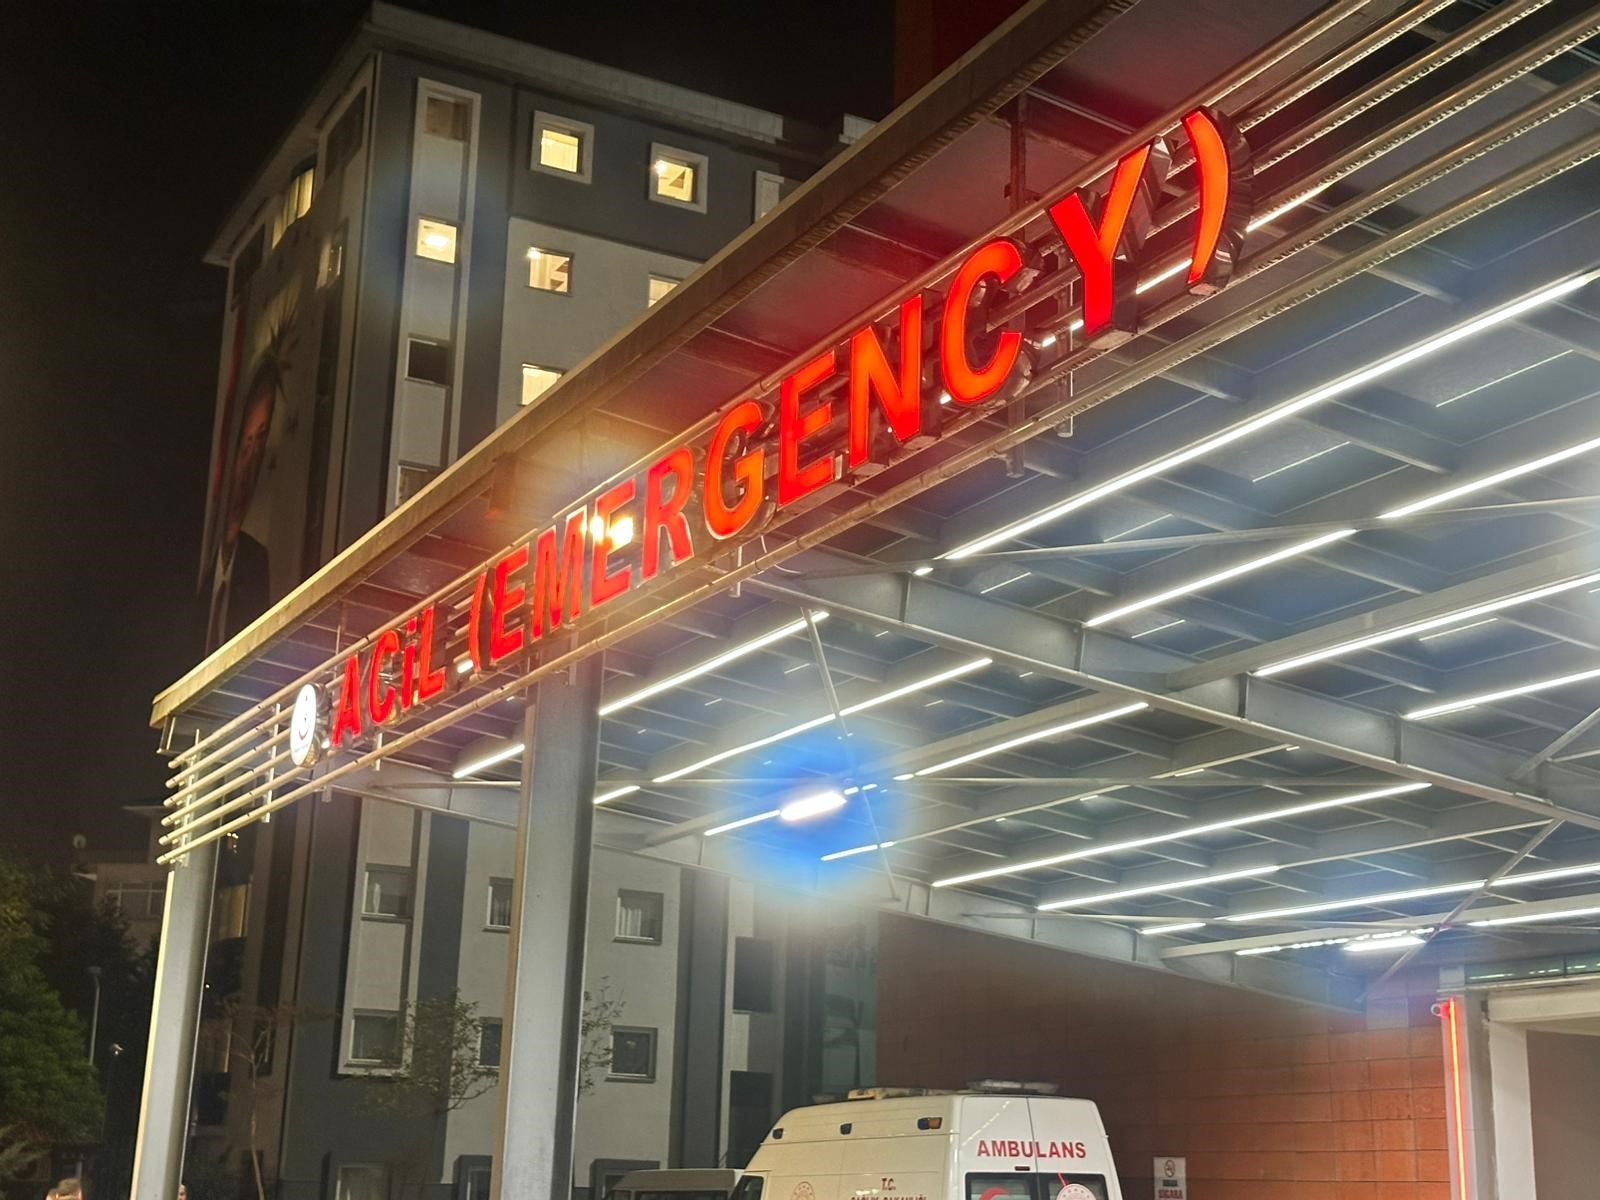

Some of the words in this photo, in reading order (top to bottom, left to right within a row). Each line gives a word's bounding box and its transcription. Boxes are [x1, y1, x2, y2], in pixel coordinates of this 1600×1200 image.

[331, 604, 446, 747] ACİL
[468, 109, 1231, 673] (EMERGENCY)
[977, 1140, 1086, 1158] AMBULANS
[881, 1177, 896, 1191] T.C.
